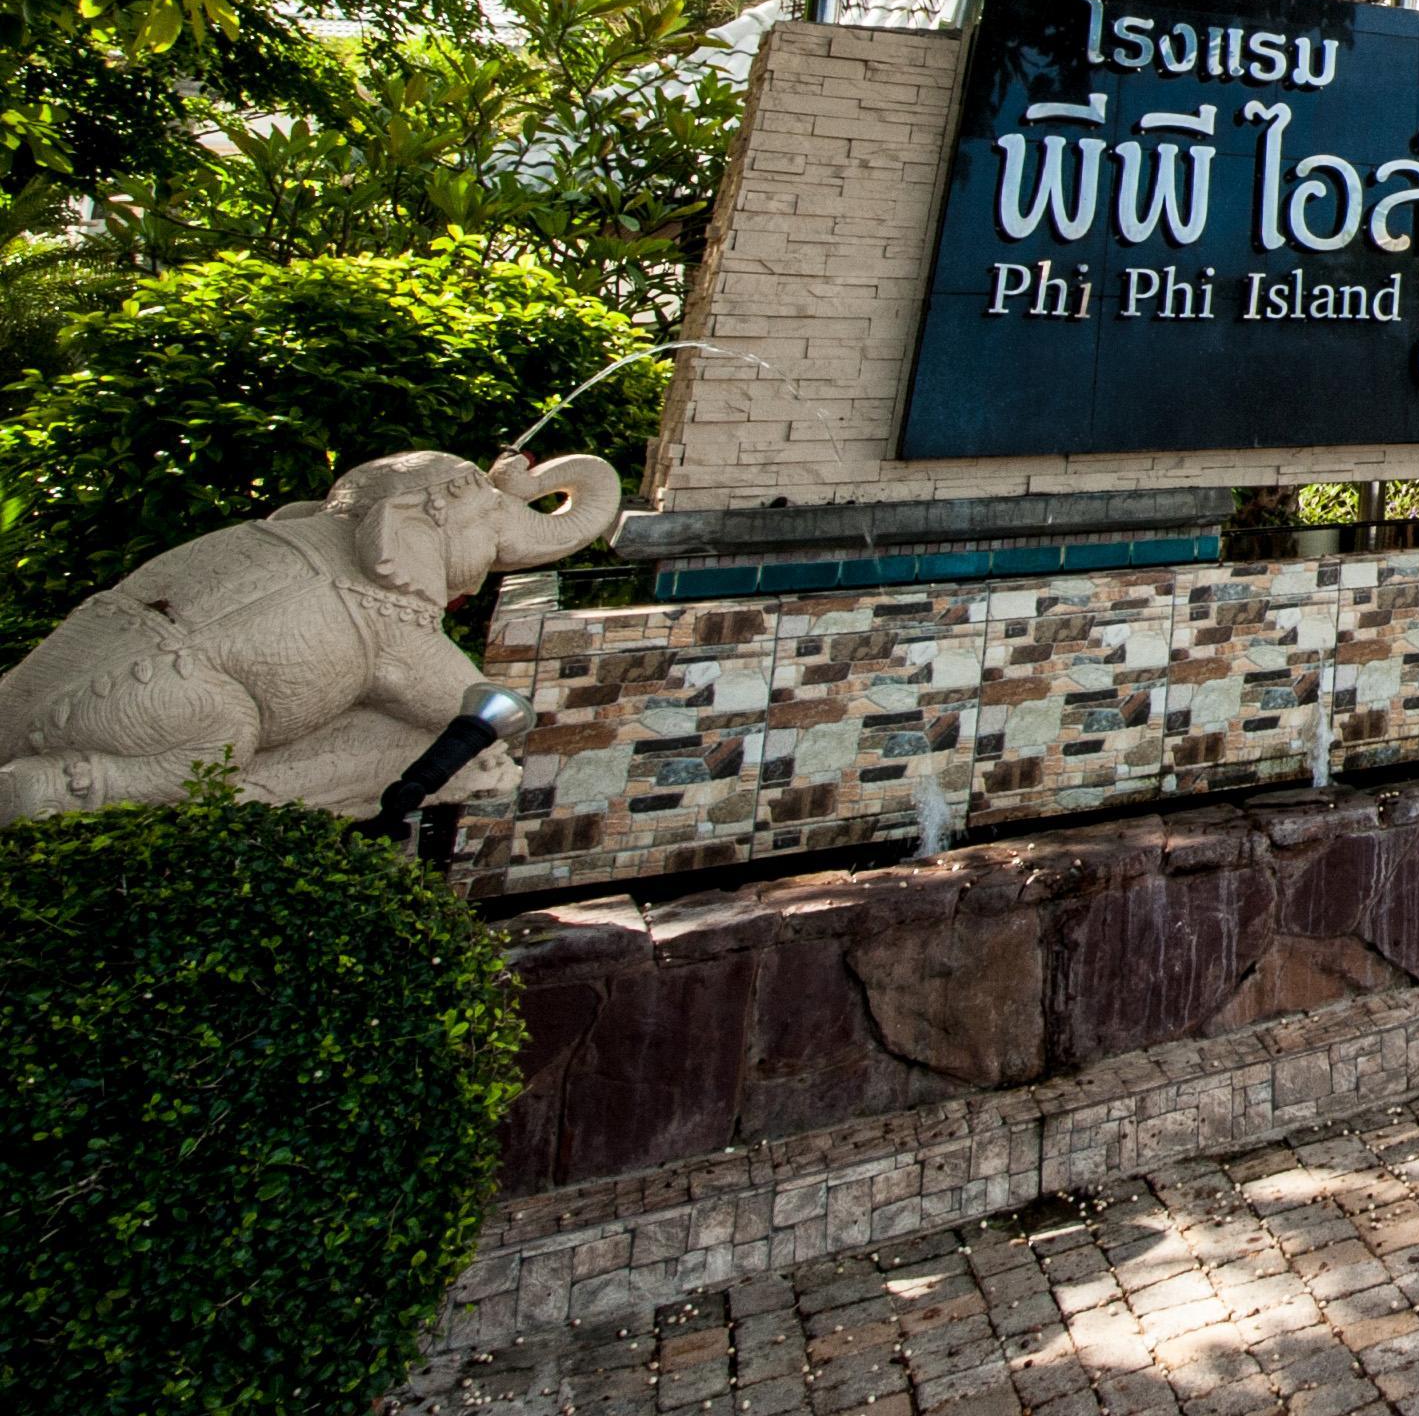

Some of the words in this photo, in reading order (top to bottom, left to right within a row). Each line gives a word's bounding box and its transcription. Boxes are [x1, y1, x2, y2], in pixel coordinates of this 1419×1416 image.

[997, 93, 1217, 245] พีพี
[988, 260, 1091, 319] Phi
[1120, 265, 1215, 319] Phi
[1243, 268, 1402, 322] Island
